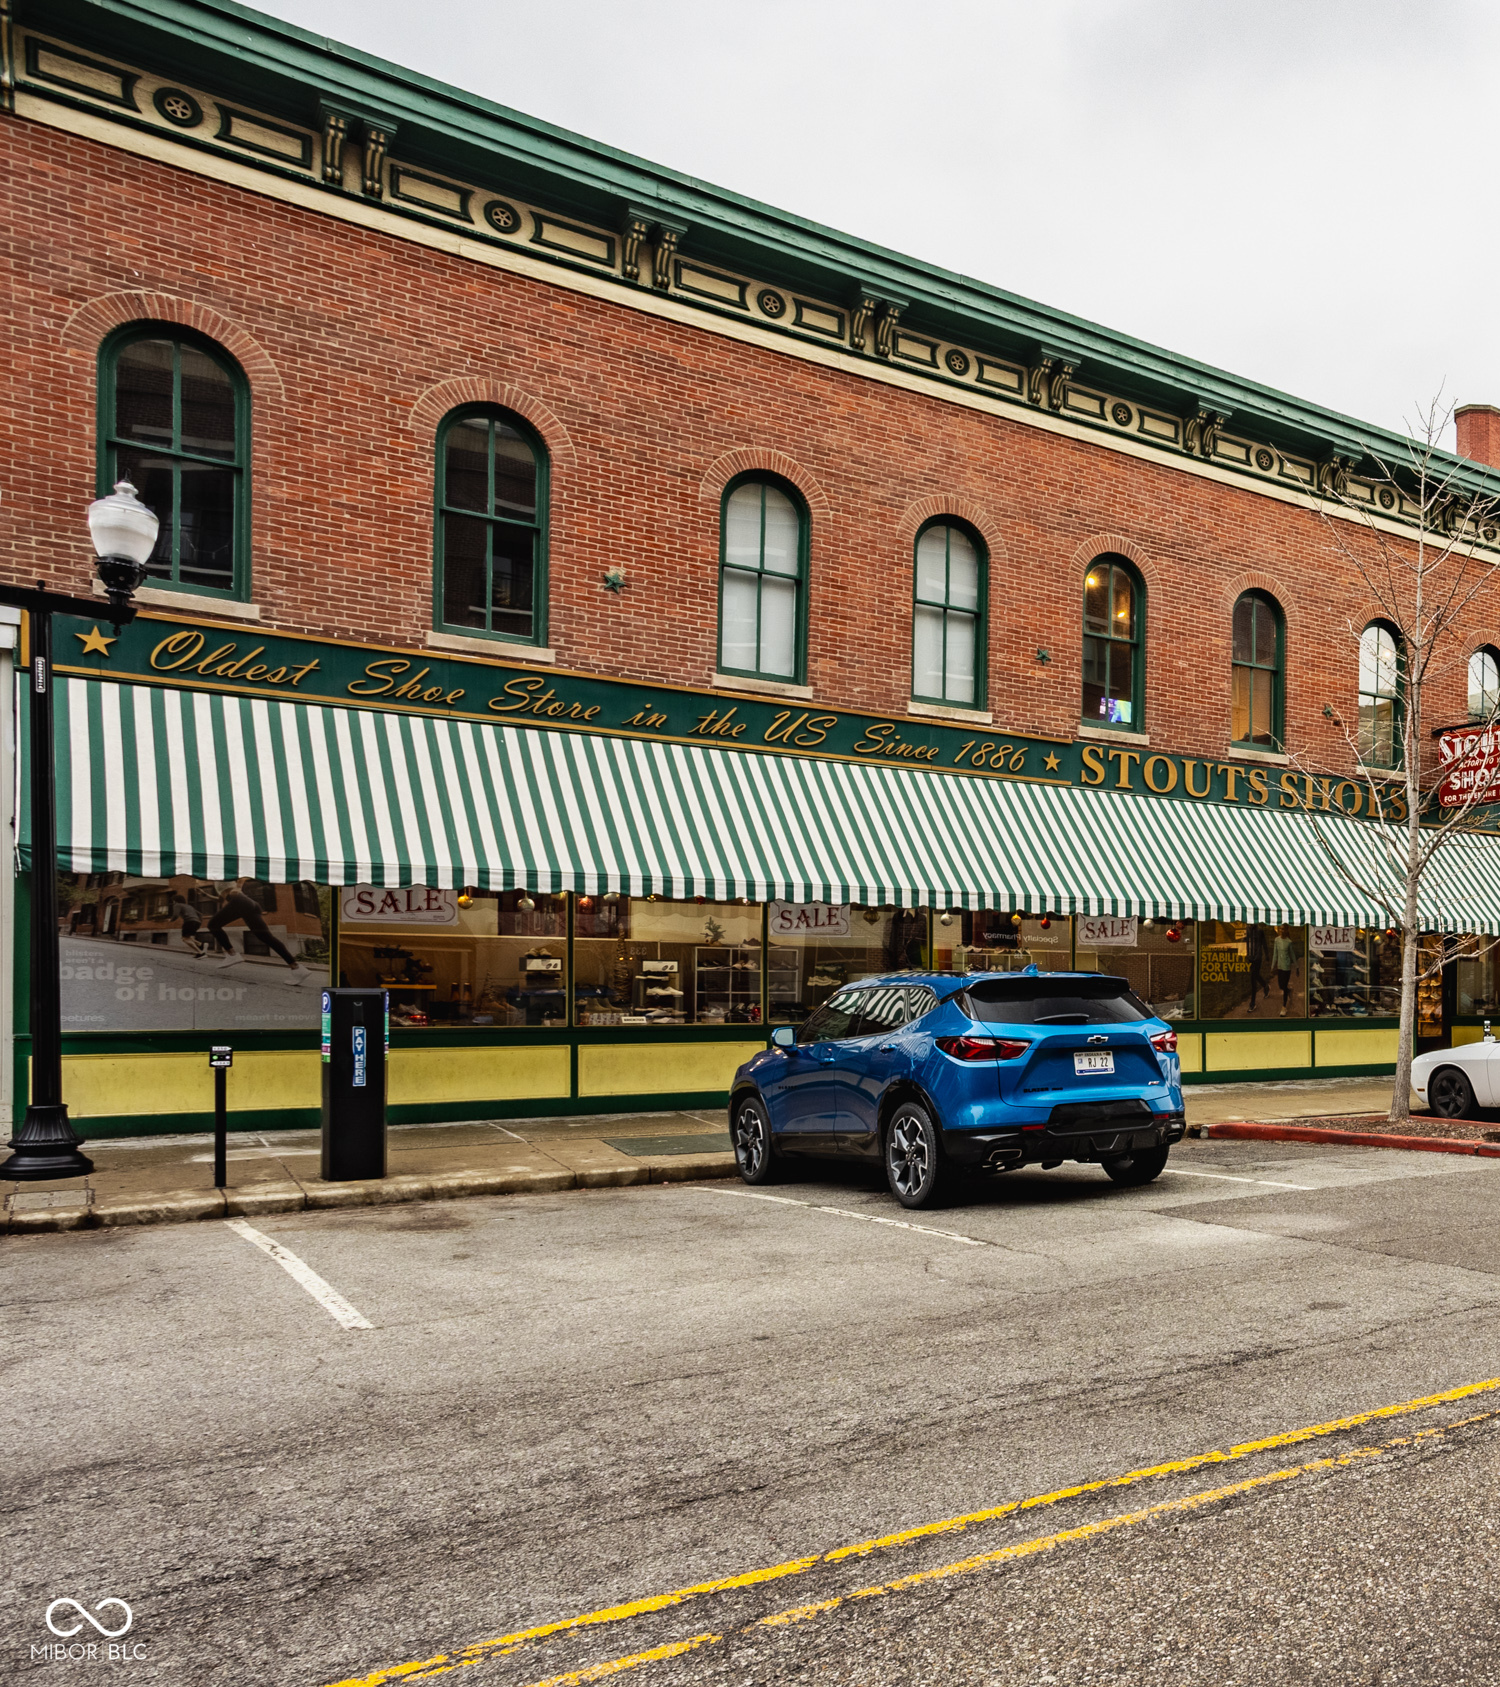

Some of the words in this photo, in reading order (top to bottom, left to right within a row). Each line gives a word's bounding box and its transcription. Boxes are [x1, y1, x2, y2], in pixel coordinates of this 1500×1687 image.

[150, 630, 320, 689] Oldest
[347, 659, 465, 707] Shoe
[488, 676, 602, 721] Store
[622, 704, 668, 729] in
[686, 706, 747, 739] the
[763, 710, 839, 747] US
[853, 723, 940, 762] Since
[953, 739, 1030, 773] 1886
[1080, 744, 1269, 806] STOUTS
[1279, 772, 1408, 820] SHOES
[1444, 794, 1457, 803] FOR
[356, 888, 447, 916] SALE
[780, 907, 841, 930] SALE
[1085, 919, 1132, 940] SALE
[1314, 928, 1351, 946] SALE
[1201, 952, 1247, 962] STABILITY
[1201, 963, 1221, 972] FOR
[1223, 963, 1252, 972] EVERY
[60, 961, 154, 984] badge
[1201, 972, 1229, 982] GOAL
[115, 983, 149, 1001] of
[159, 983, 248, 1001] honor
[355, 1029, 364, 1051] PAY
[355, 1054, 364, 1084] HERE
[1088, 1058, 1097, 1068] RJ
[1100, 1057, 1108, 1067] 22
